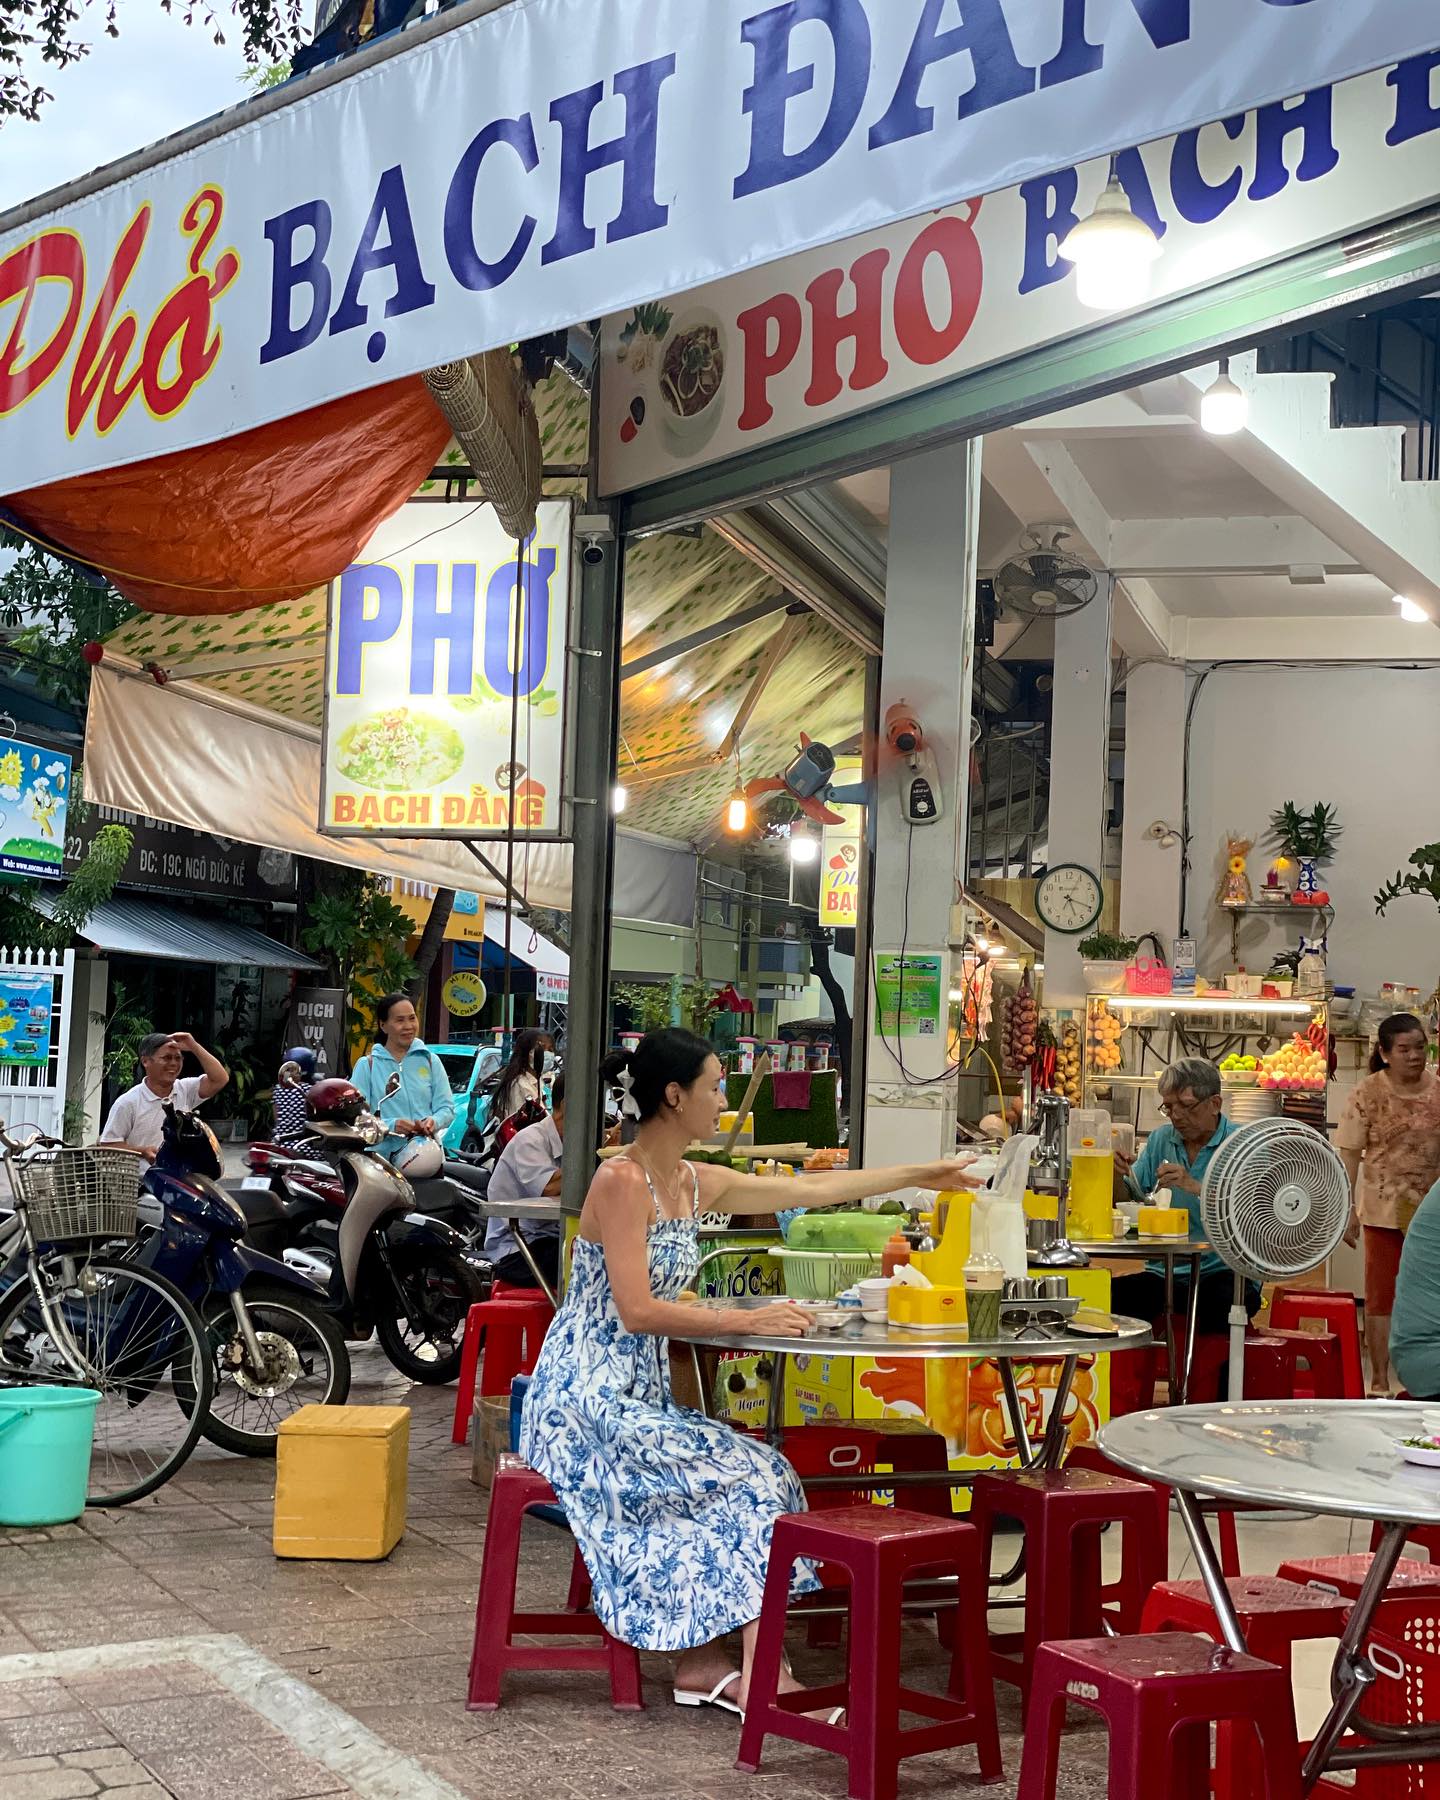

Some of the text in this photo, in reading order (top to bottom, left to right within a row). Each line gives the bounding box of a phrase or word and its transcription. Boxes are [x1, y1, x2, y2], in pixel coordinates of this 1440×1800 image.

[259, 53, 677, 364] BẠCH
[334, 518, 559, 698] PHỞ
[333, 784, 545, 831] BẠCH ĐẰNG
[140, 849, 158, 874] ĐC:
[163, 853, 182, 877] 19C
[185, 855, 207, 881] NGÔ
[210, 858, 230, 884] ĐỨC
[827, 891, 857, 916] BẠ
[297, 1002, 334, 1020] DỊCH
